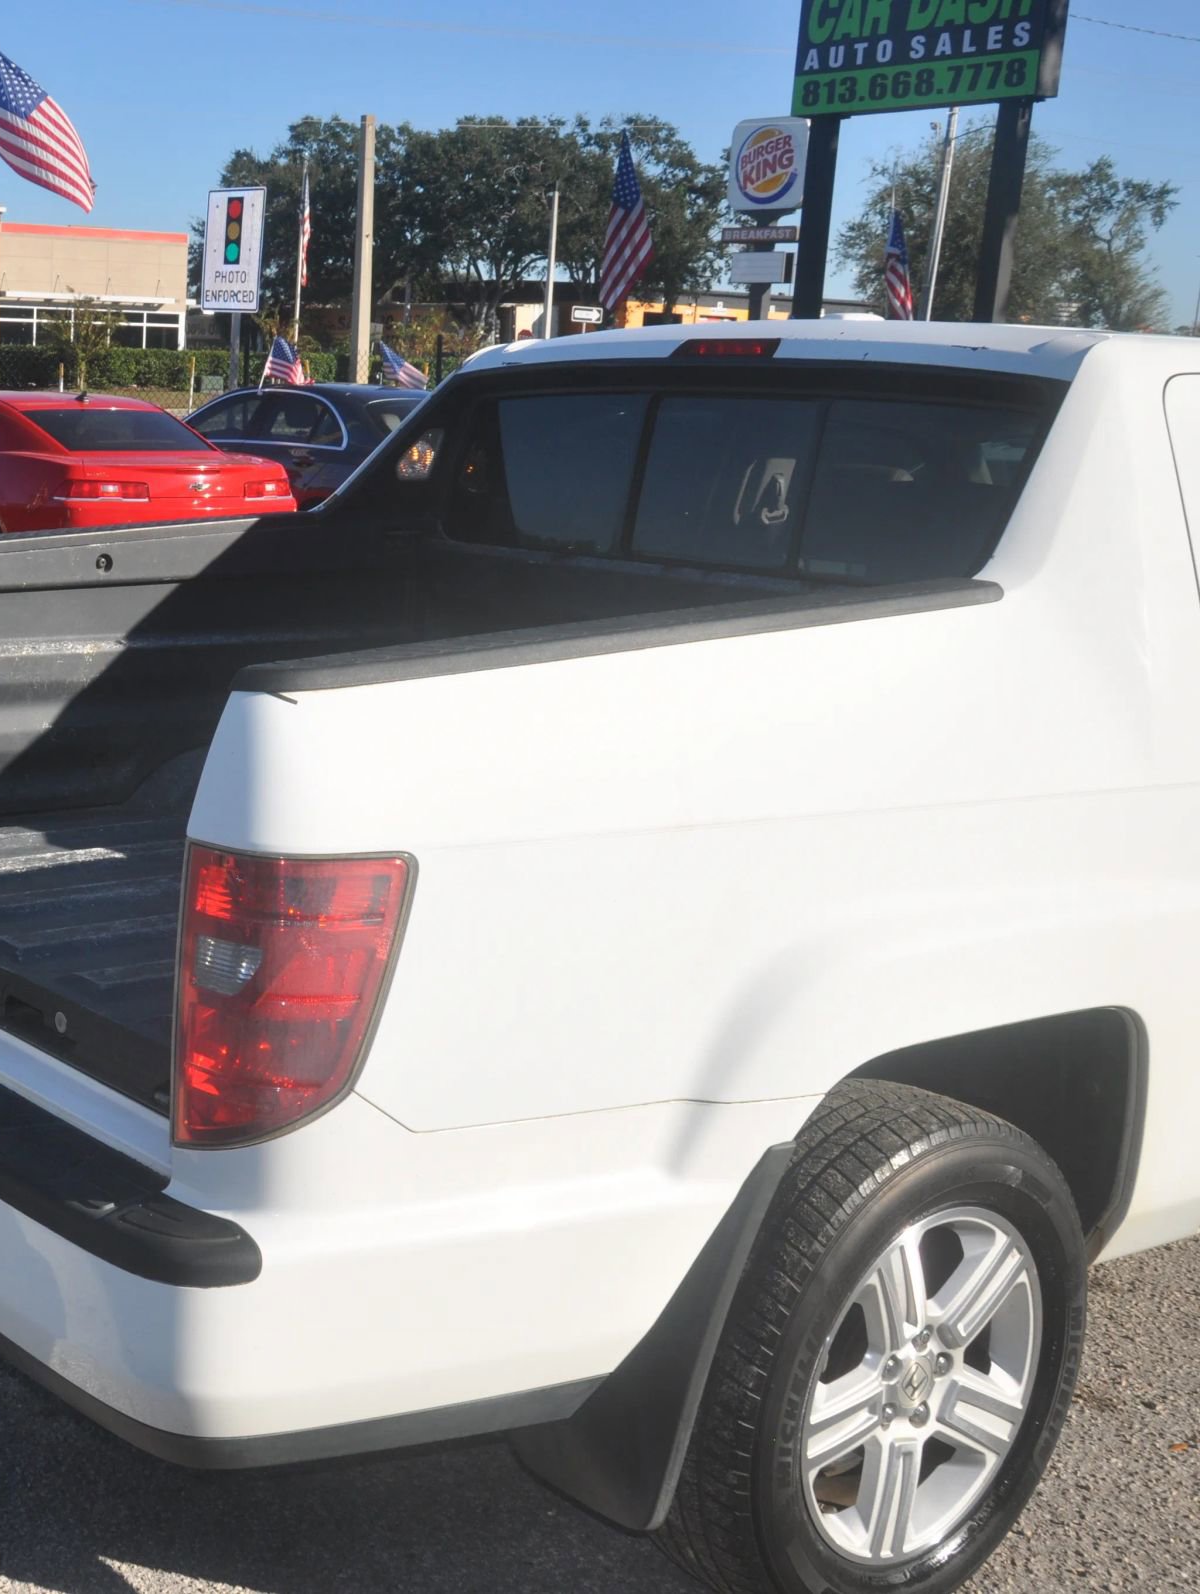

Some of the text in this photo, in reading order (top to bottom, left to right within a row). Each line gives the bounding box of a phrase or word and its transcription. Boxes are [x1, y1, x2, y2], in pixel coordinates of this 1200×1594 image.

[803, 21, 1031, 71] AUTO SALES
[801, 57, 1028, 108] 813.668.7778
[740, 134, 793, 170] BURGER
[742, 148, 794, 192] KING
[723, 228, 793, 241] BREAKFAST
[214, 270, 247, 284] PHOTO
[205, 289, 255, 303] ENFORCED
